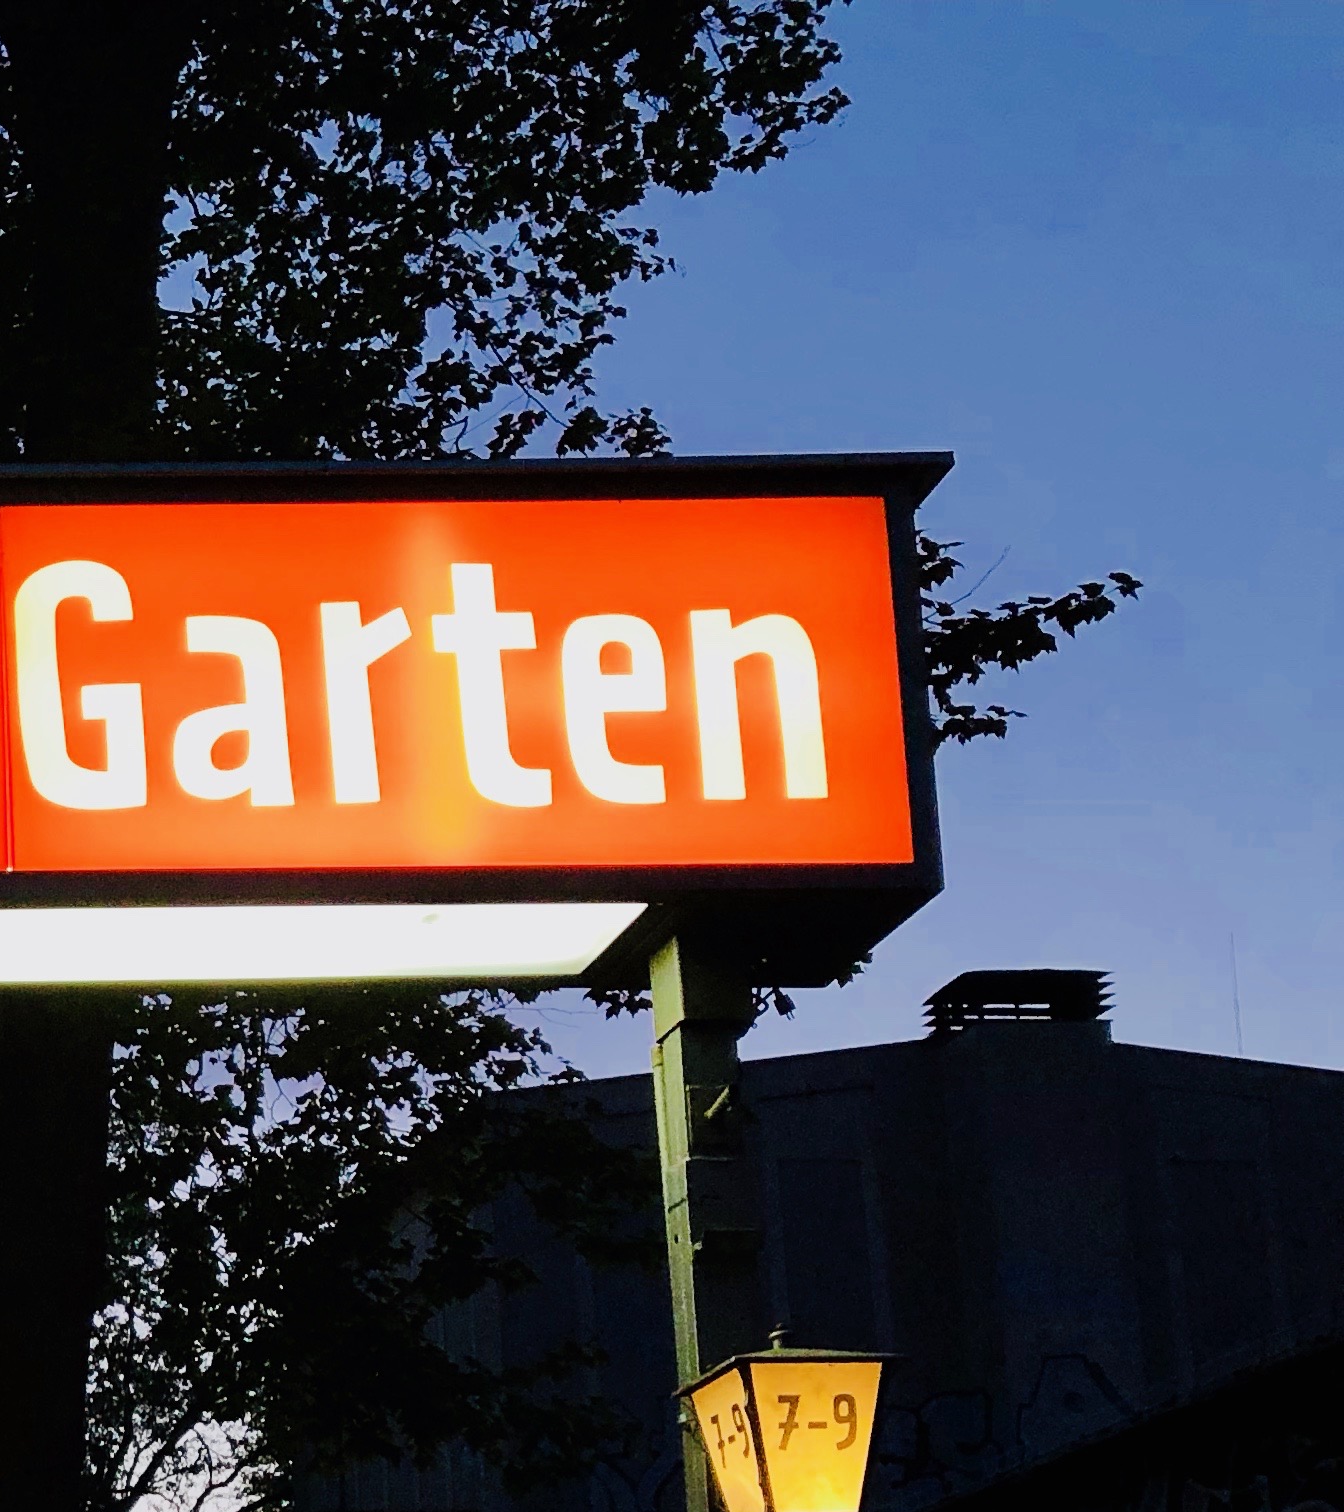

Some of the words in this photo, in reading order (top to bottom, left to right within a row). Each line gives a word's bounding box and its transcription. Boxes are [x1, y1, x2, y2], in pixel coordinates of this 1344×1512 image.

[14, 559, 829, 812] Garten
[710, 1403, 750, 1469] 7-9
[776, 1393, 858, 1451] 7-9
